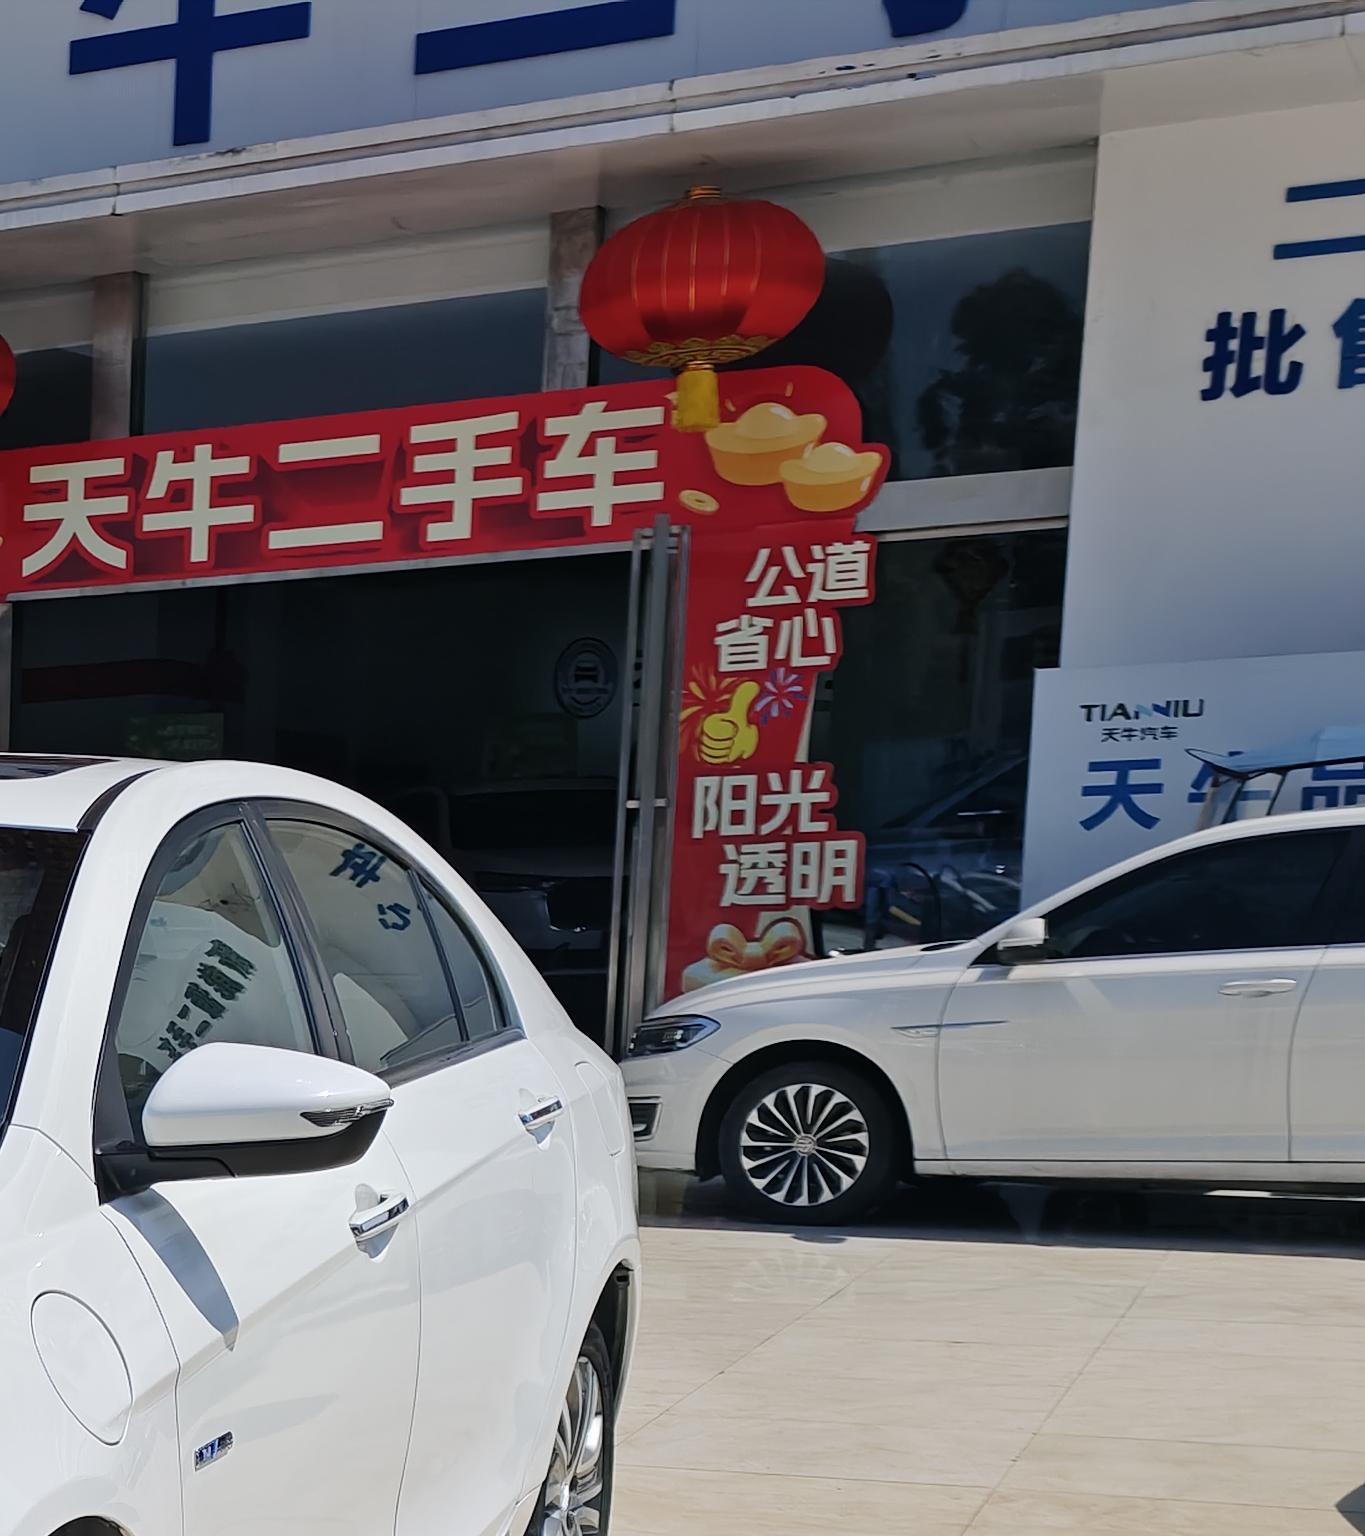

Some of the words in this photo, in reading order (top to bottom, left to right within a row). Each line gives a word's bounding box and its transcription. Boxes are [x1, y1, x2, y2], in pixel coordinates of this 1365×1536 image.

[20, 401, 665, 578] 天牛二手车
[744, 540, 871, 607] 公道
[714, 607, 838, 673] 省心
[691, 768, 831, 840] 阳光
[719, 838, 859, 907] 透明
